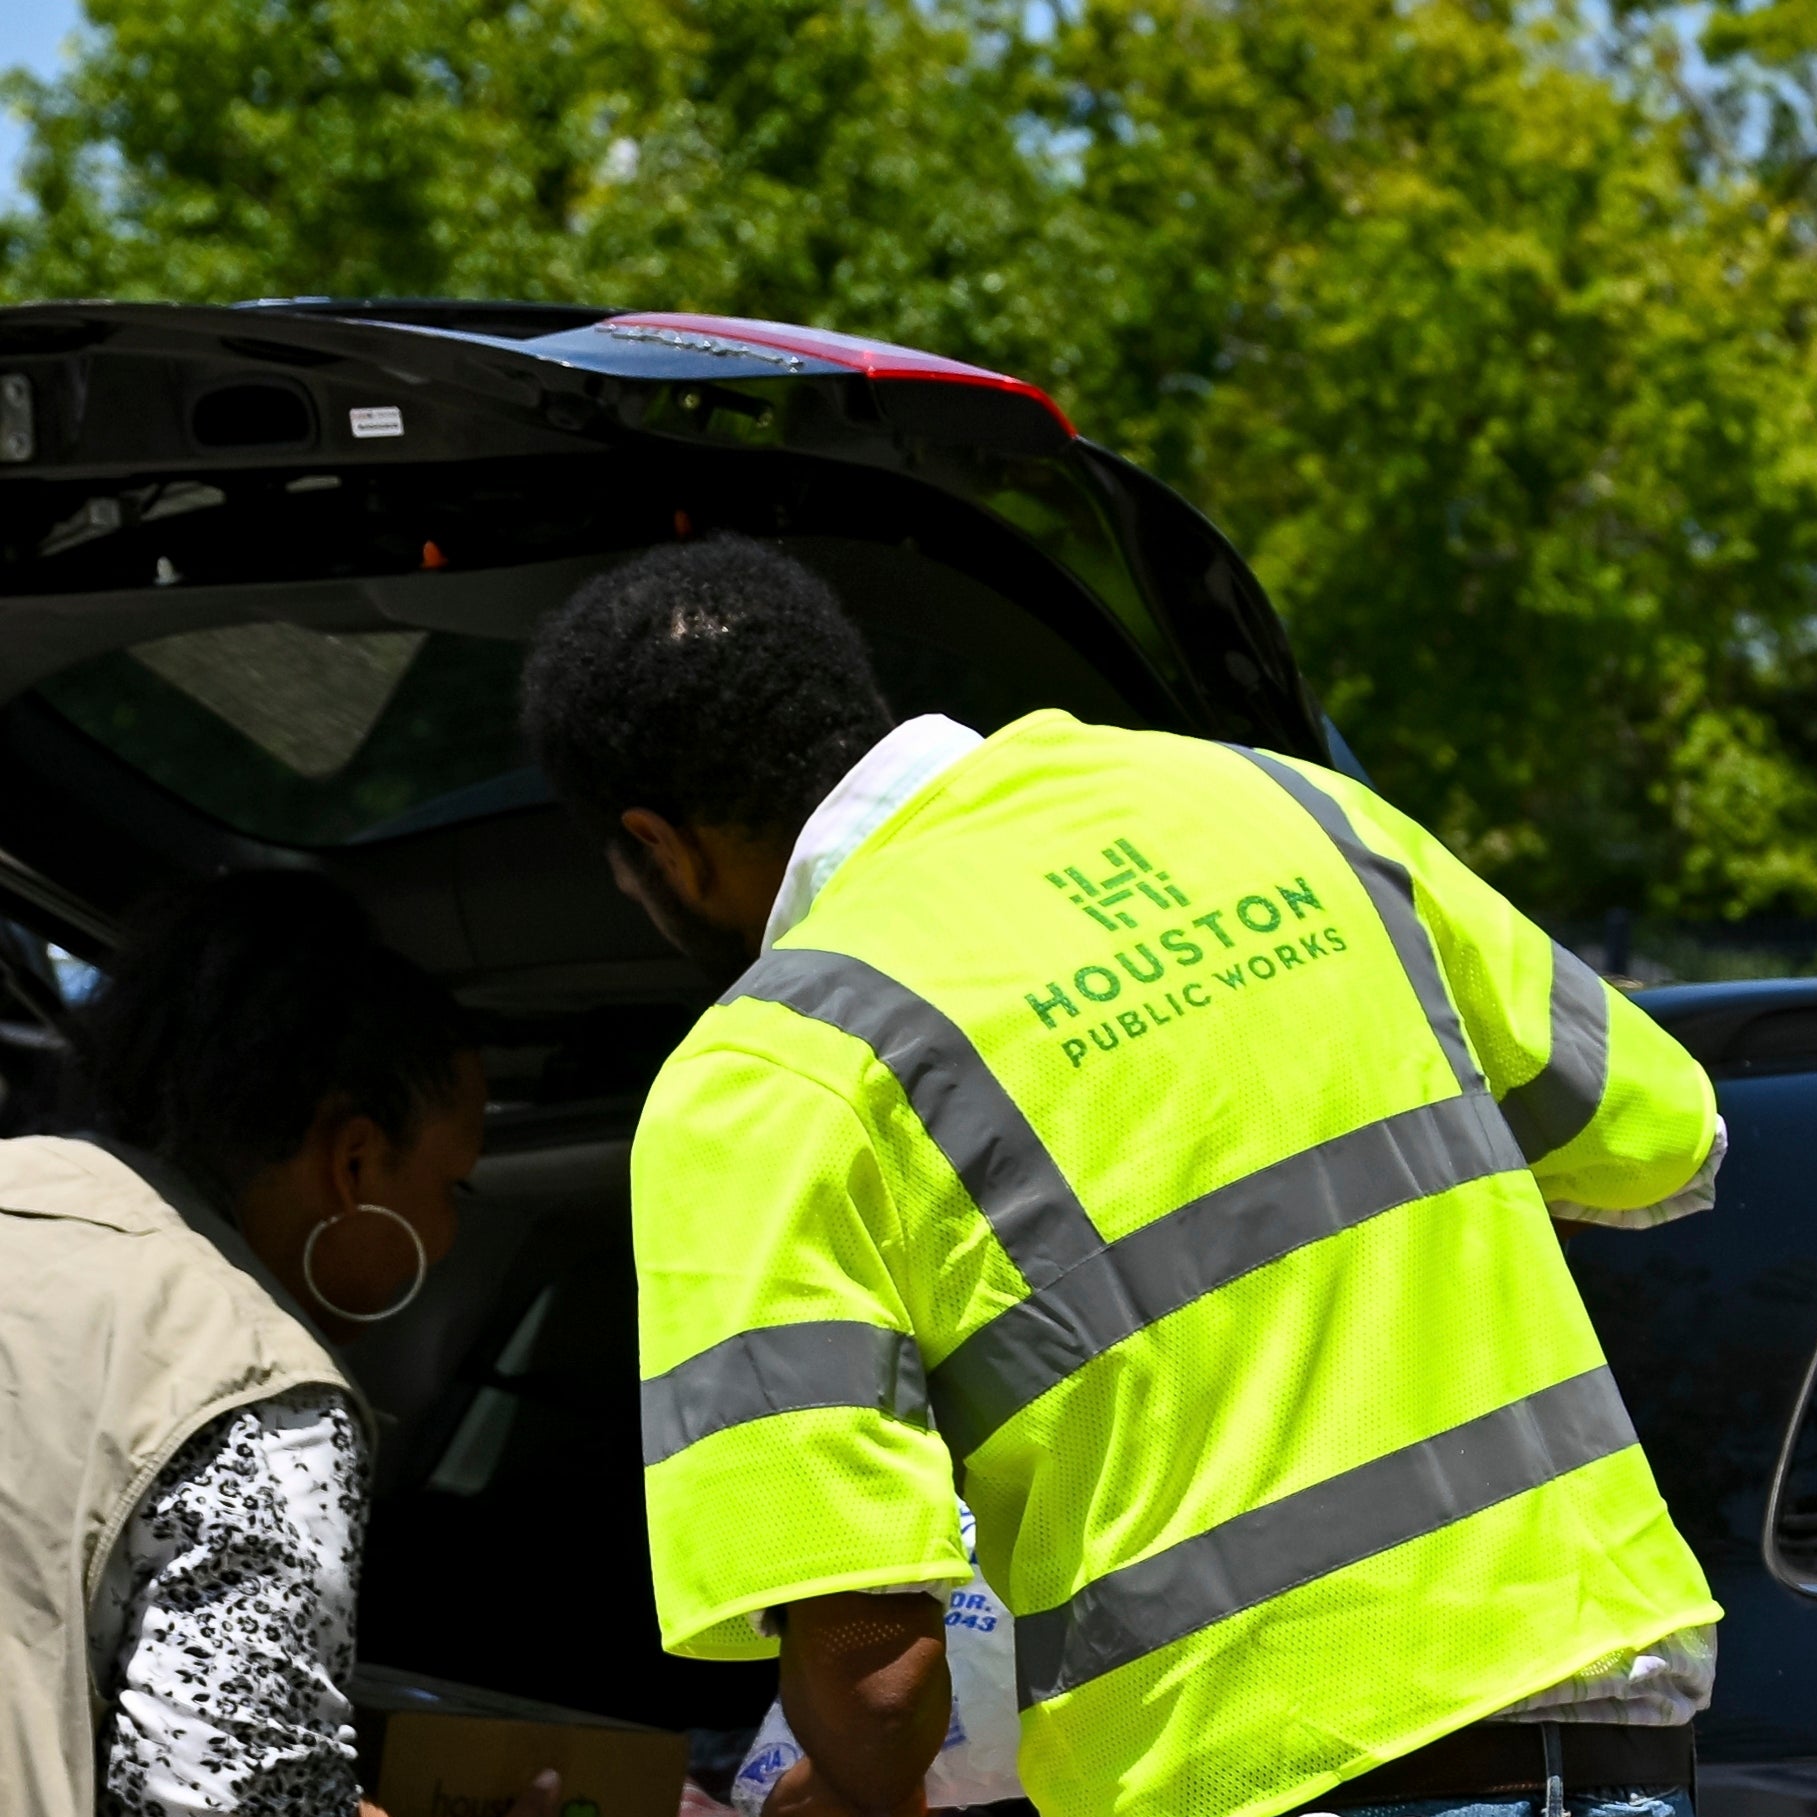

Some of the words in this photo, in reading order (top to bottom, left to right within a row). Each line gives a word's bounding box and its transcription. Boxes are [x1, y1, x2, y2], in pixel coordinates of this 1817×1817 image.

[1023, 877, 1326, 1029] HOUSTON
[1061, 983, 1212, 1068] PUBLIC
[1212, 926, 1348, 991] WORKS
